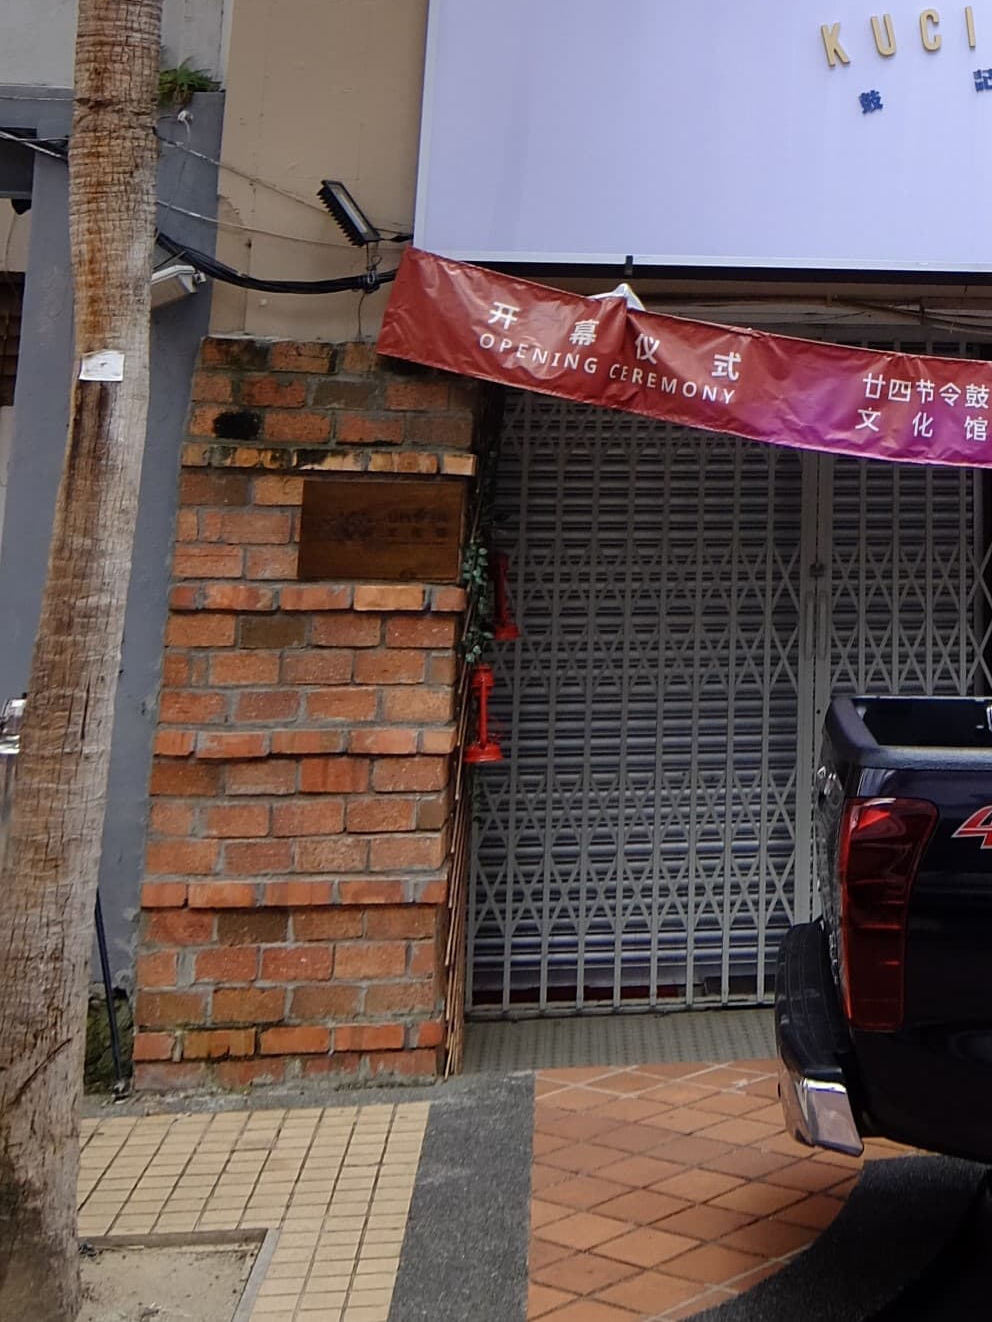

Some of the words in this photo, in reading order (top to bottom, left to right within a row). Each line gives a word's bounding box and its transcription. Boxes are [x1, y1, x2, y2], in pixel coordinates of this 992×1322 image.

[820, 5, 977, 67] KUCI
[479, 333, 598, 374] OPENING
[608, 363, 736, 405] CEREMONY
[488, 301, 742, 381] 开幕仪式
[862, 372, 990, 410] 廿四节令鼓
[854, 407, 989, 442] 文化馆
